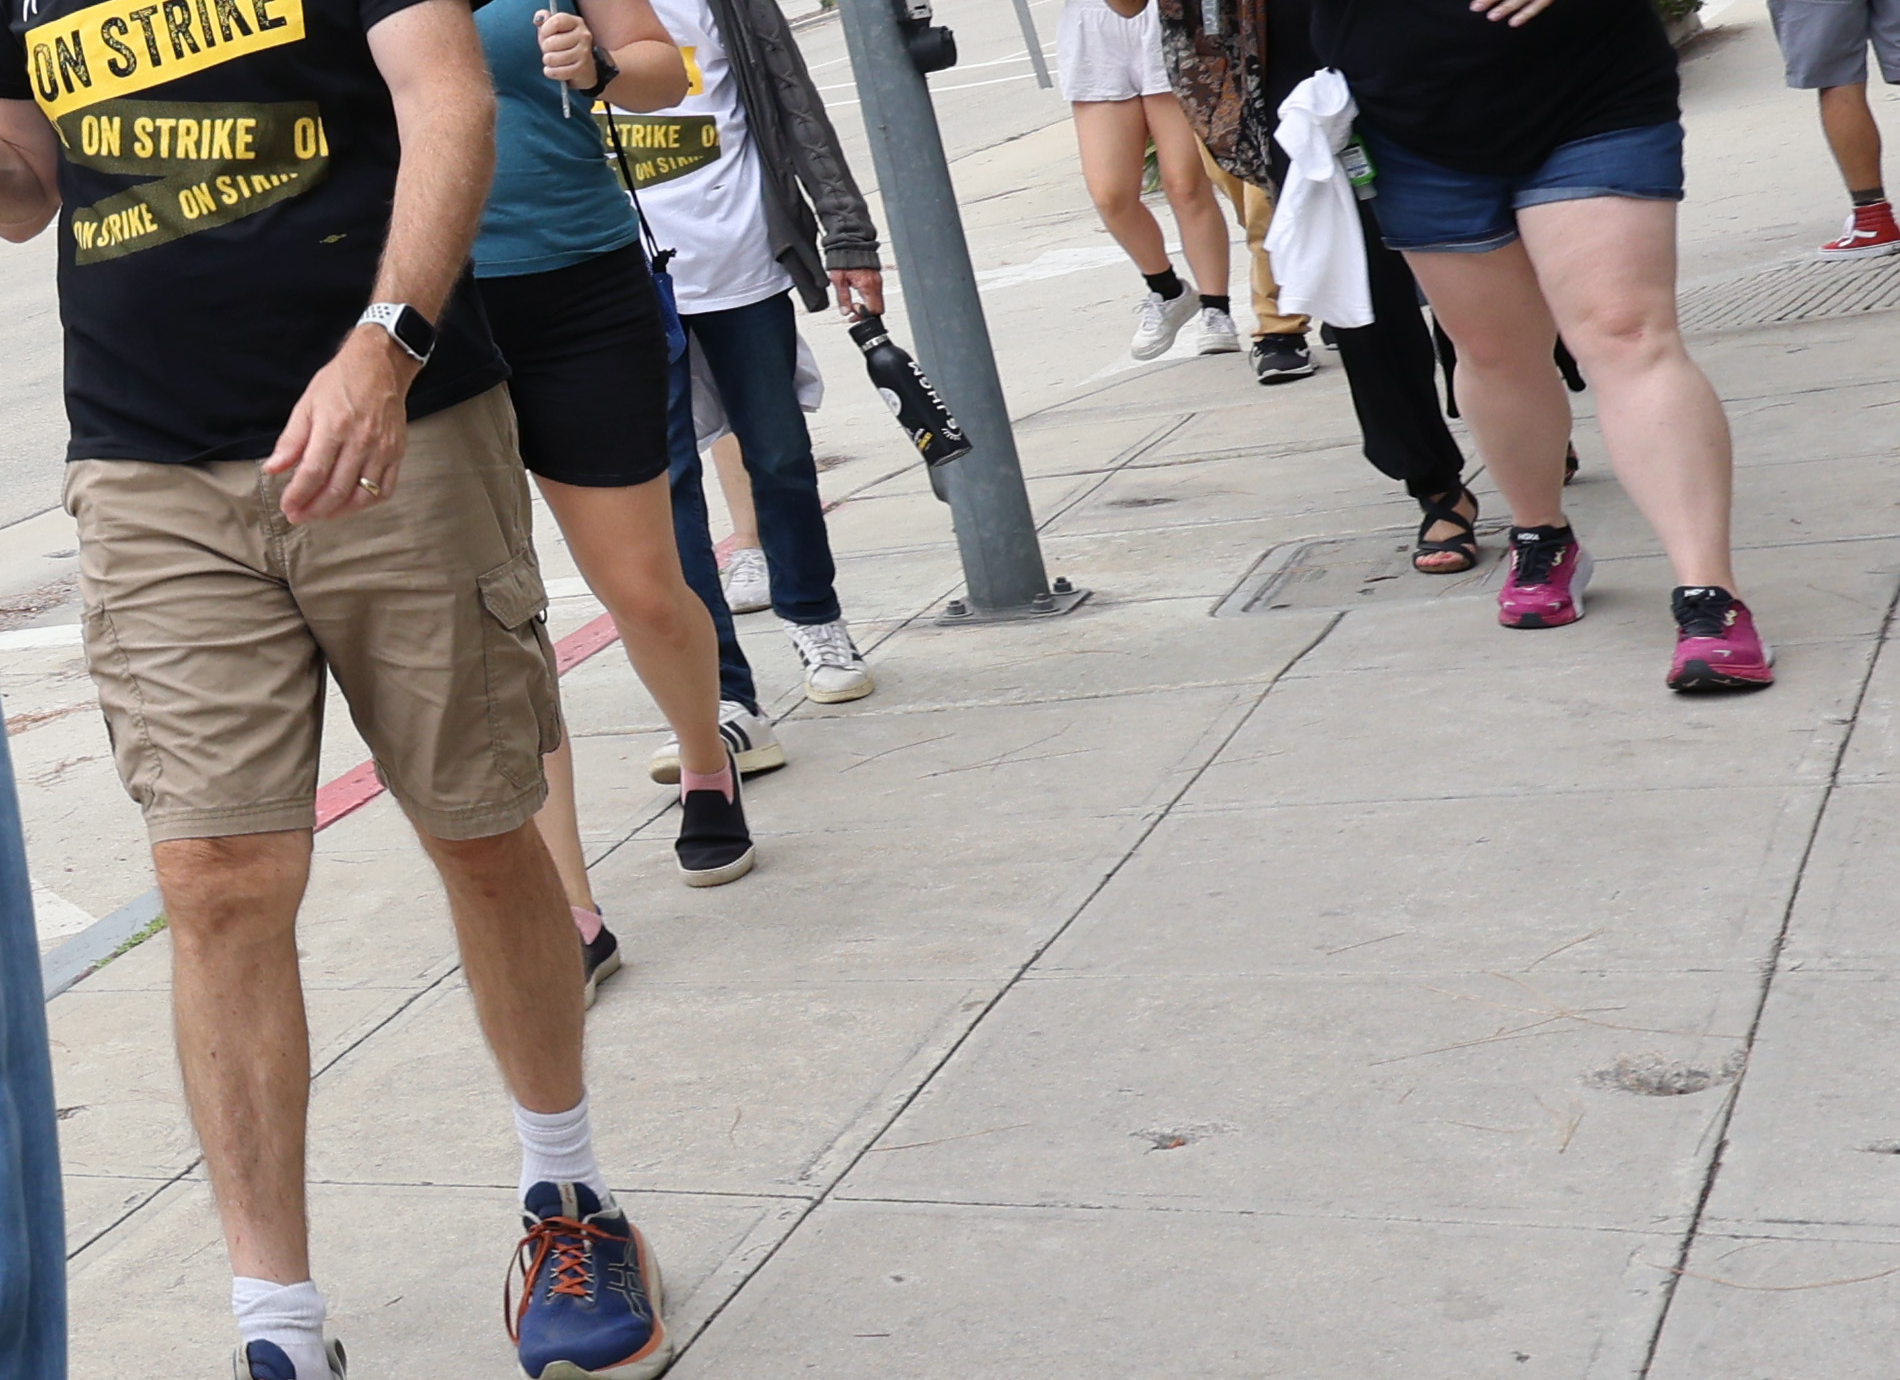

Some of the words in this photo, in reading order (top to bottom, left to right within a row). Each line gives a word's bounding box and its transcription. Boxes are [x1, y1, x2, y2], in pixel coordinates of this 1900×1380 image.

[33, 29, 92, 103] ON
[81, 115, 121, 157] ON
[133, 118, 256, 160] STRIKE
[606, 123, 681, 148] STRIKE
[635, 161, 656, 181] ON
[179, 184, 217, 220] ON
